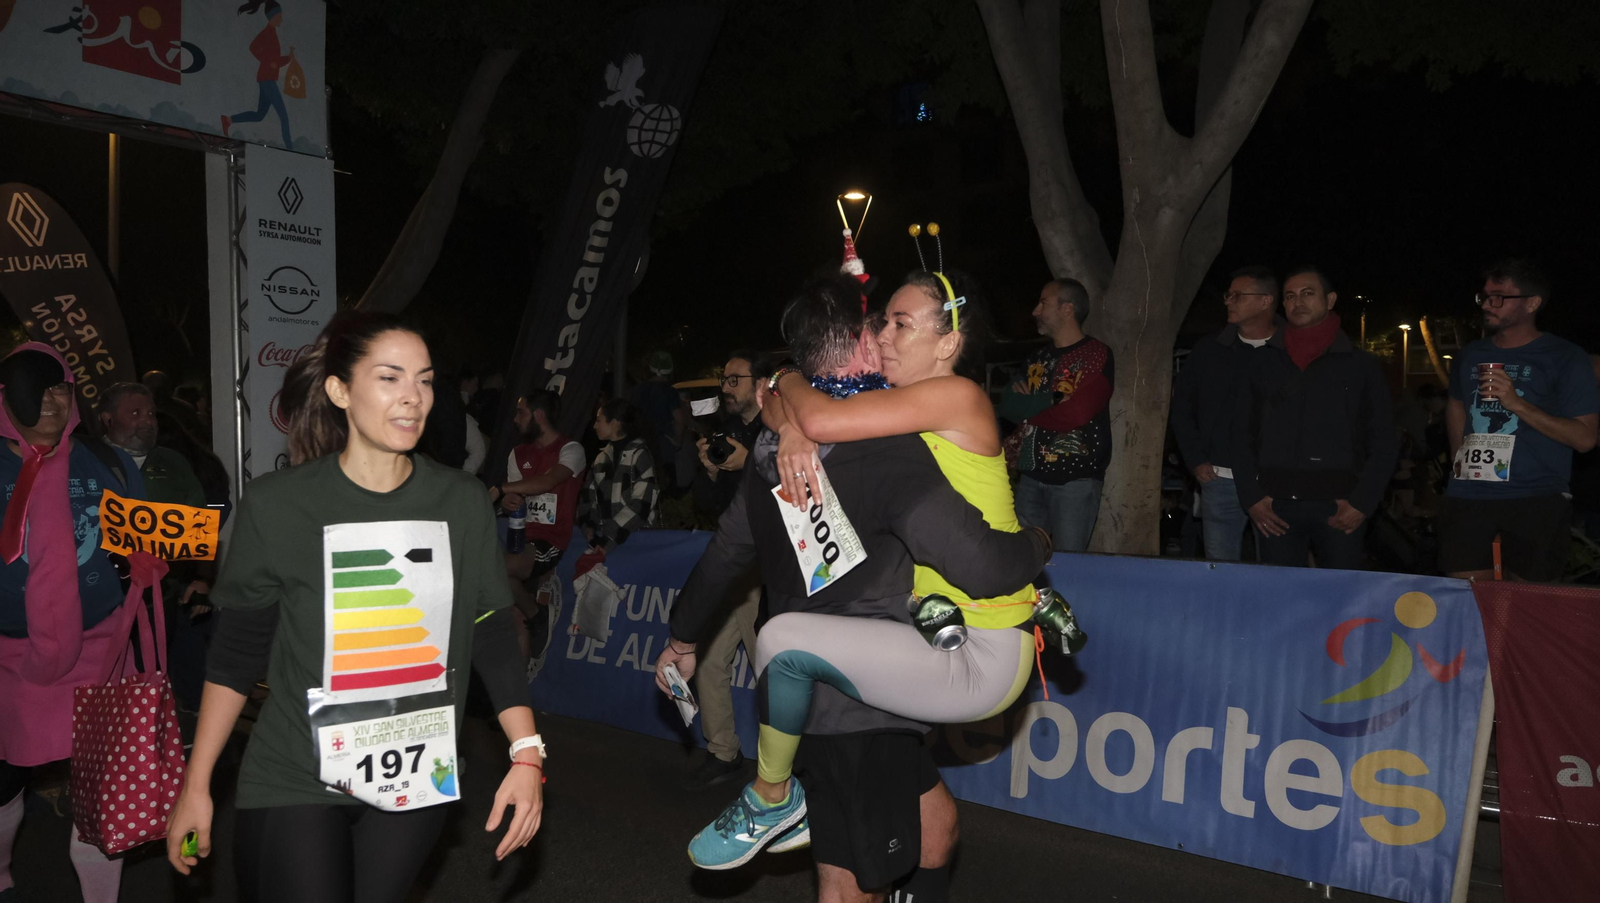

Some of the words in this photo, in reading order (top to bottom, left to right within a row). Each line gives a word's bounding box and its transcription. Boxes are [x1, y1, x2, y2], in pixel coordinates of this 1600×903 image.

[258, 218, 322, 237] RENAULT
[258, 230, 279, 240] SYRSA
[261, 283, 320, 297] NISSAN
[1464, 449, 1495, 464] 183
[528, 501, 547, 513] 444
[104, 498, 185, 539] SOS
[353, 724, 371, 737] XIV
[373, 720, 394, 733] SAN
[395, 710, 447, 729] SILVESTRE
[354, 731, 391, 749] CIUDAD
[393, 729, 406, 742] DE
[356, 743, 426, 783] 197
[938, 700, 1447, 847] eportes
